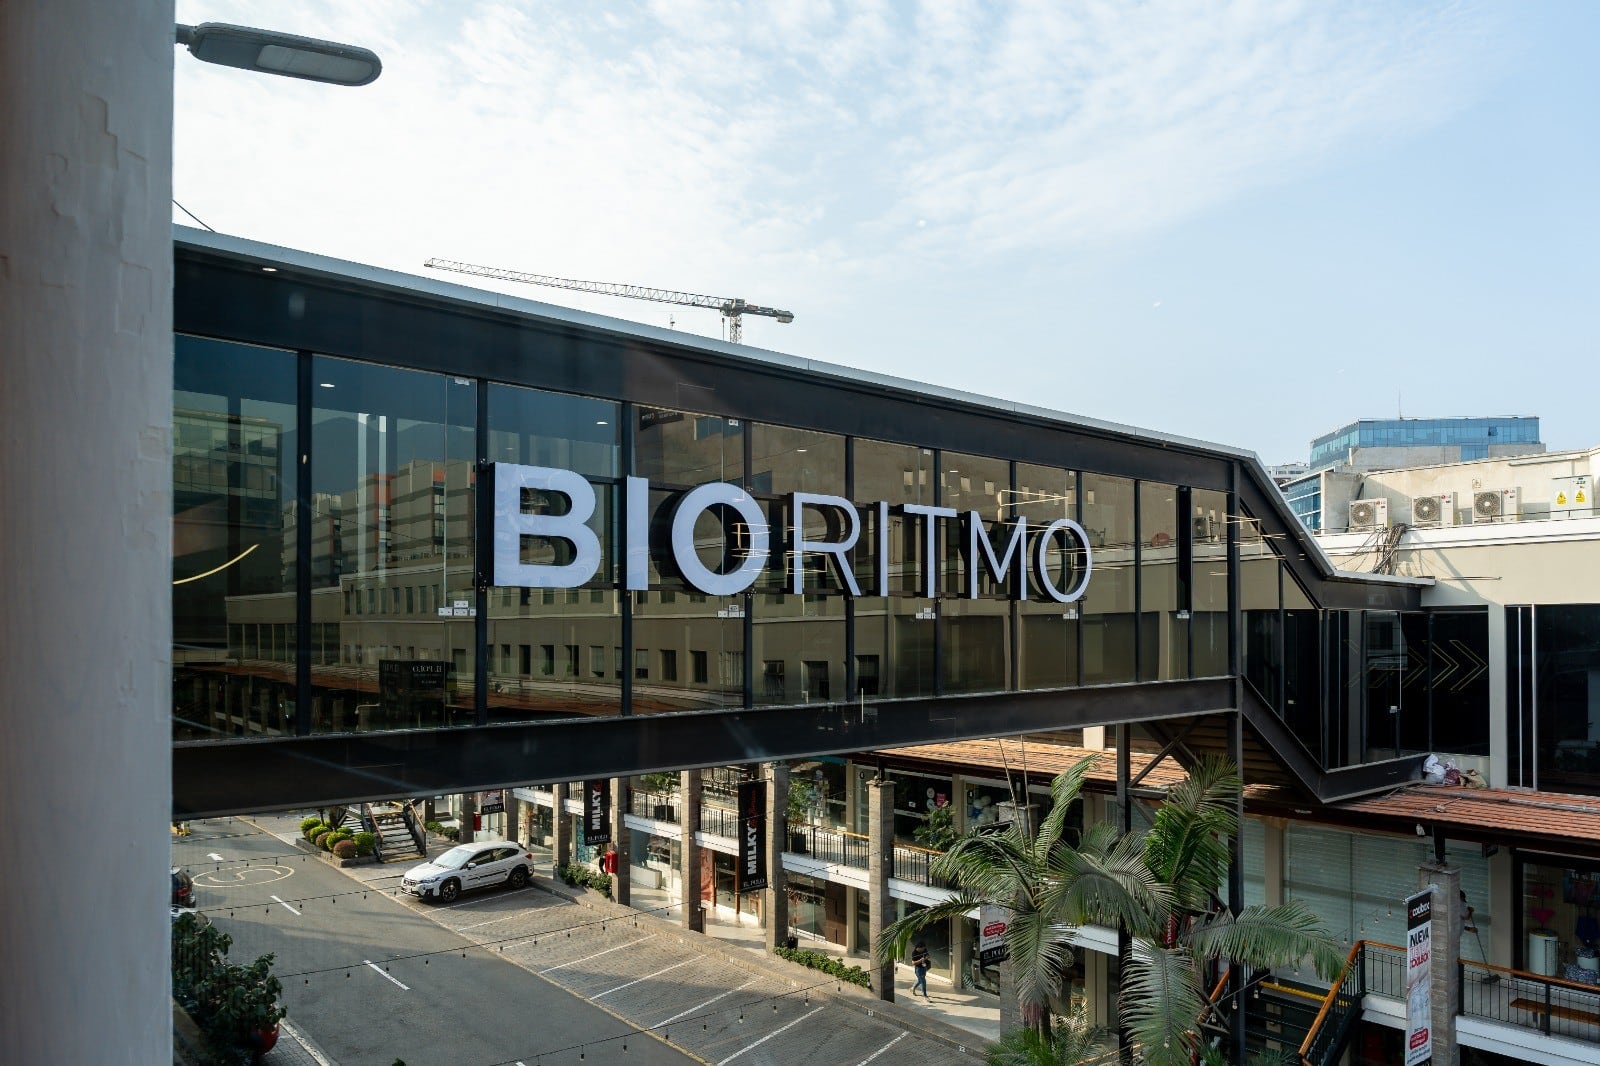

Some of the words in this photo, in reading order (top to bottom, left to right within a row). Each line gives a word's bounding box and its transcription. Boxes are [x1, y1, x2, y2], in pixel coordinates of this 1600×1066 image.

[493, 462, 1093, 603] BIORITMO
[592, 789, 601, 830] MILKY
[747, 821, 757, 875] MILKY
